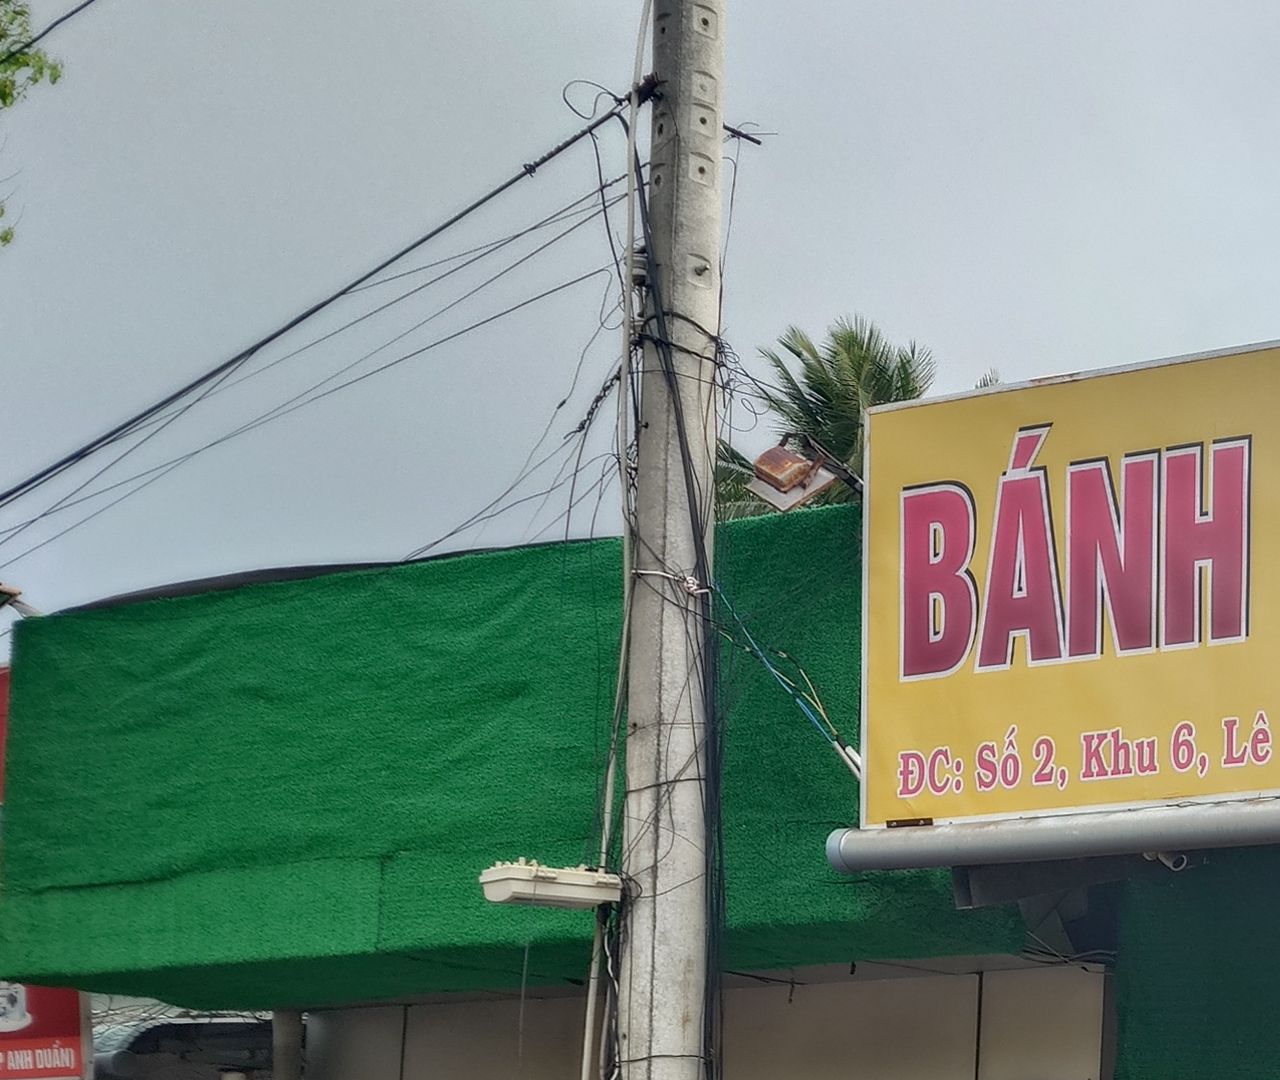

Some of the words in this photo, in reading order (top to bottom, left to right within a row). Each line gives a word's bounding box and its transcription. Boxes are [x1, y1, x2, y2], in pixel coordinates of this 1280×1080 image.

[898, 424, 1252, 683] BÁNH
[898, 748, 964, 800] ĐC:
[974, 724, 1022, 792] Số
[1031, 735, 1068, 790] 2,
[1079, 724, 1159, 782] Khu
[1168, 720, 1208, 778] 6,
[1221, 712, 1275, 768] Lê
[7, 1050, 33, 1070] ANH
